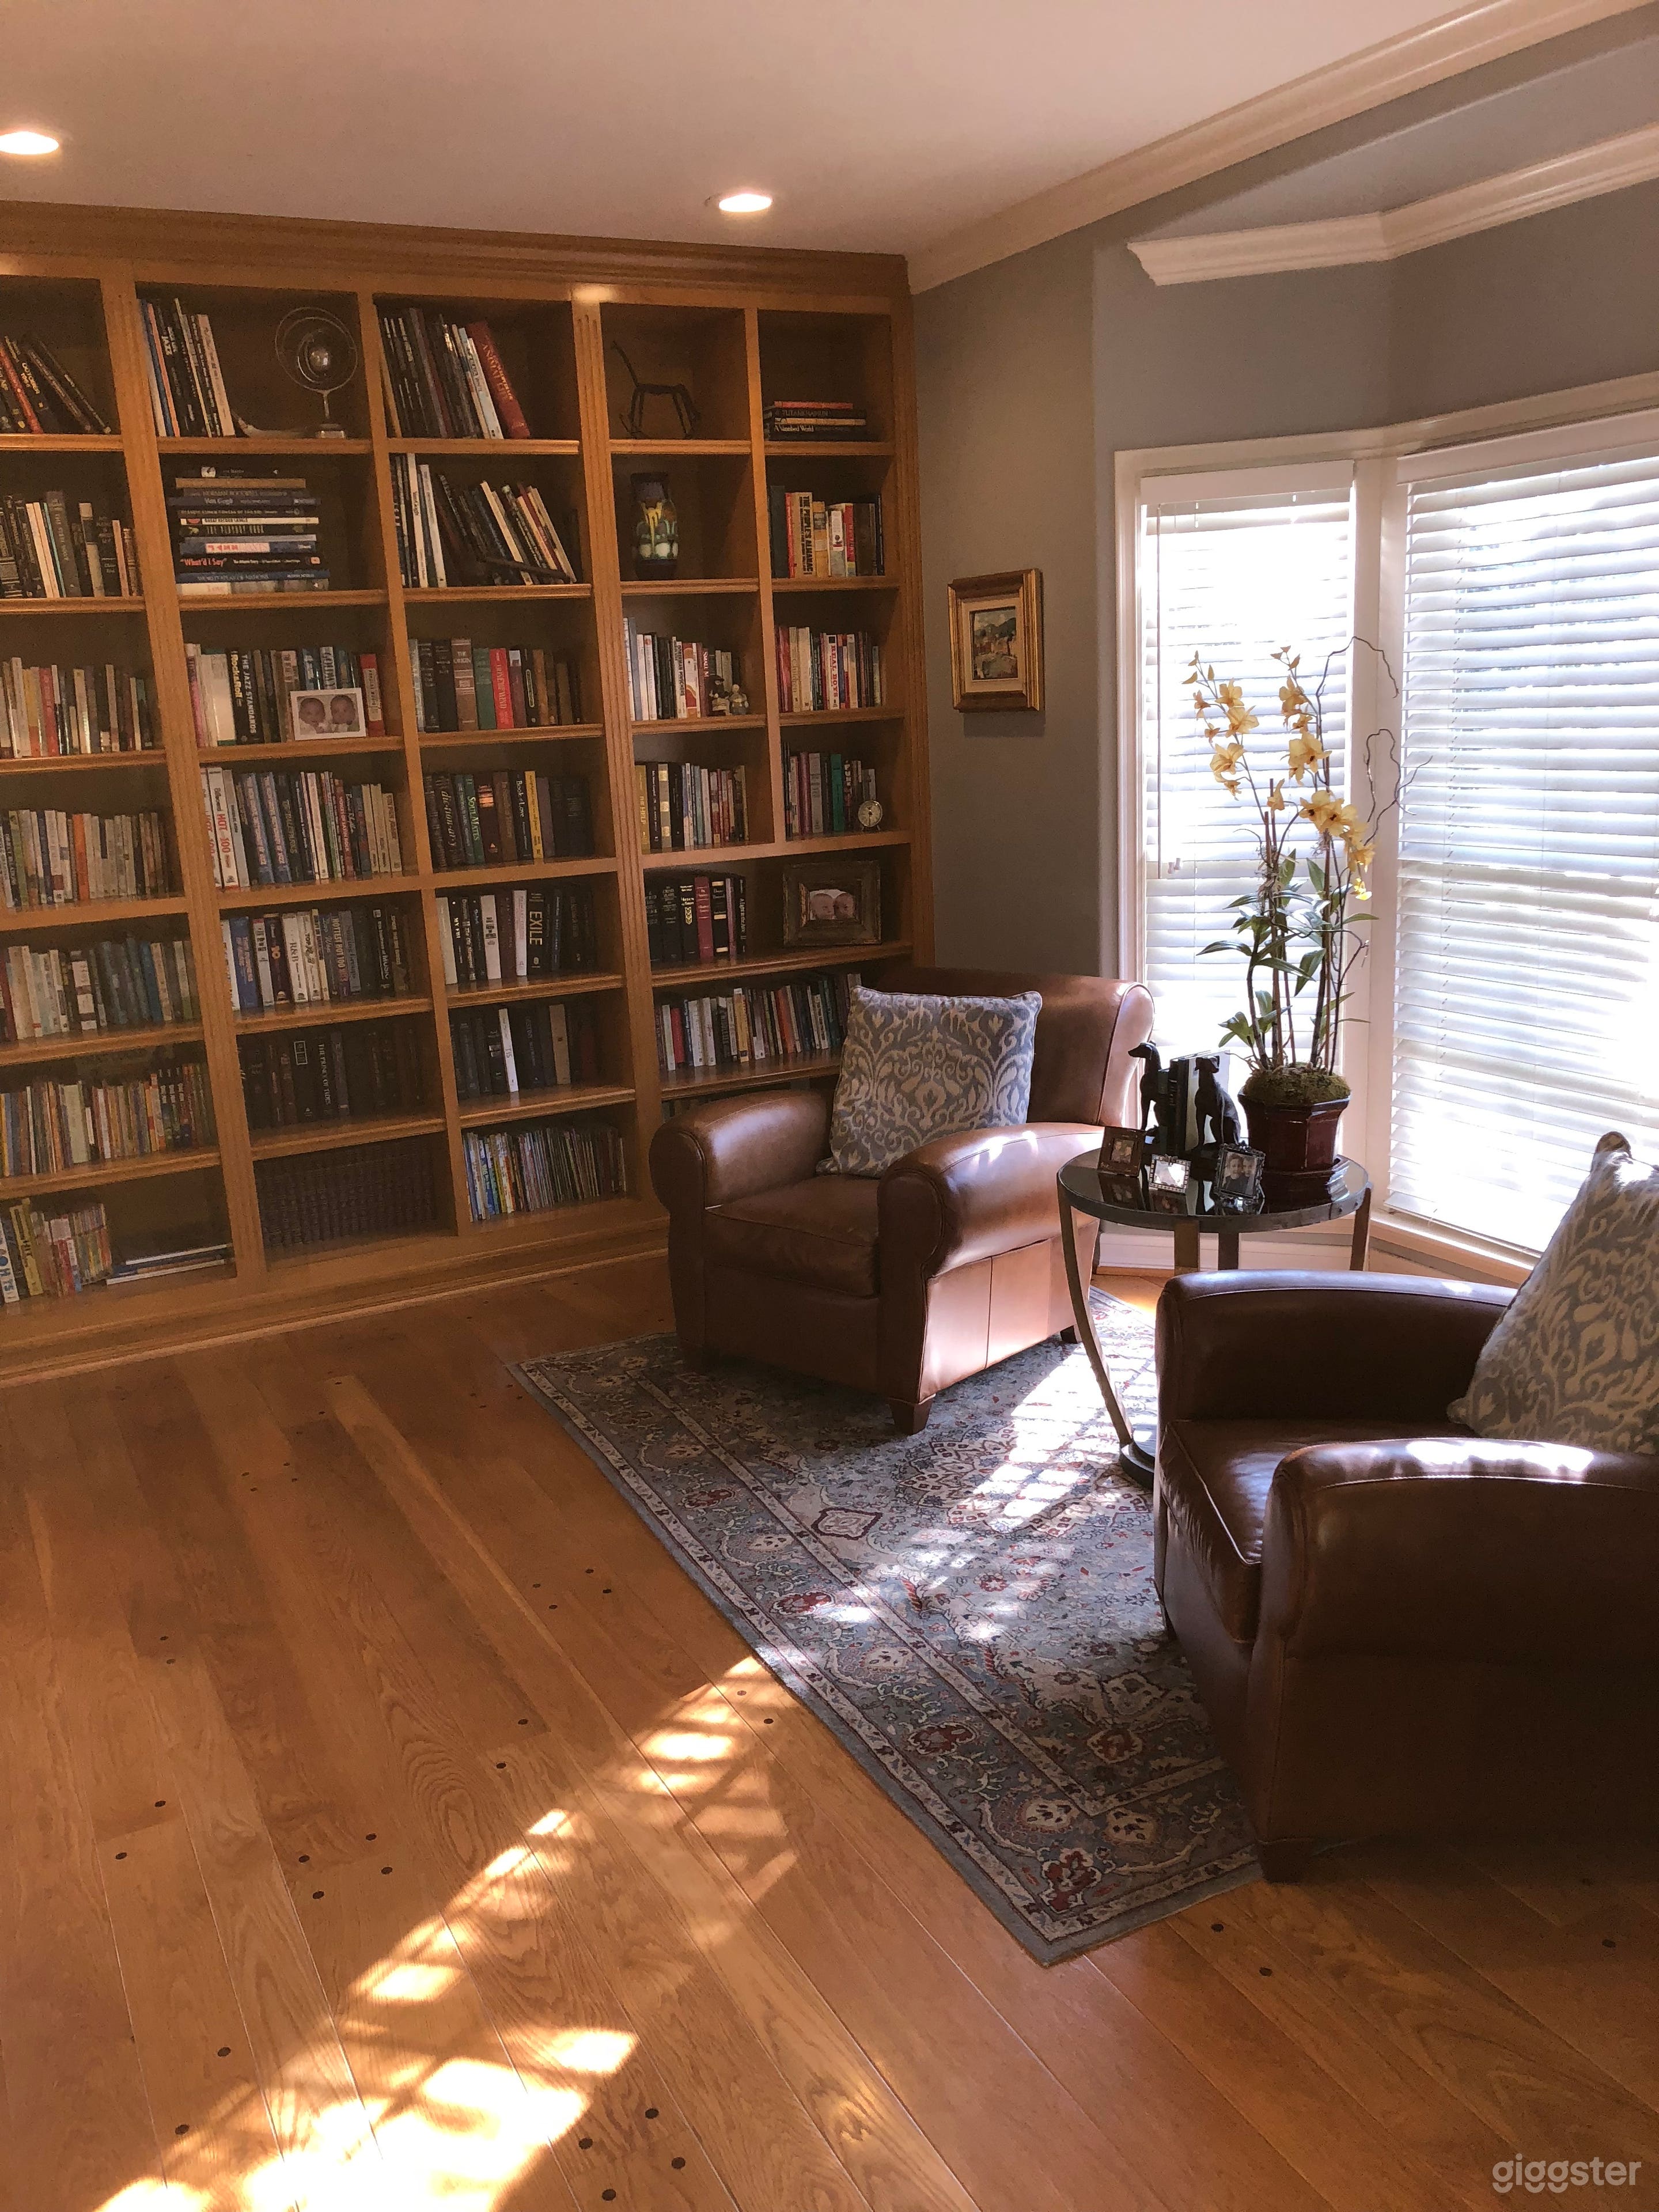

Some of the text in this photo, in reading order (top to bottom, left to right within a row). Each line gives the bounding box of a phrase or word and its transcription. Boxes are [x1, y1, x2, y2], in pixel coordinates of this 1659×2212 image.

[161, 334, 173, 355] JAZZ
[21, 362, 40, 395] OCTOBER
[240, 654, 257, 734] THE JAZZ STANDARDS
[515, 779, 525, 797] Book
[517, 801, 527, 817] Love
[216, 813, 228, 831] HOT
[470, 816, 482, 841] MATES
[219, 836, 230, 853] 100
[331, 918, 341, 943] HOTTEST
[453, 917, 460, 928] MY
[529, 911, 543, 945] EXILE
[289, 942, 298, 962] R&B
[335, 942, 344, 956] HOT
[336, 956, 346, 968] 100
[382, 955, 391, 979] MUSIC
